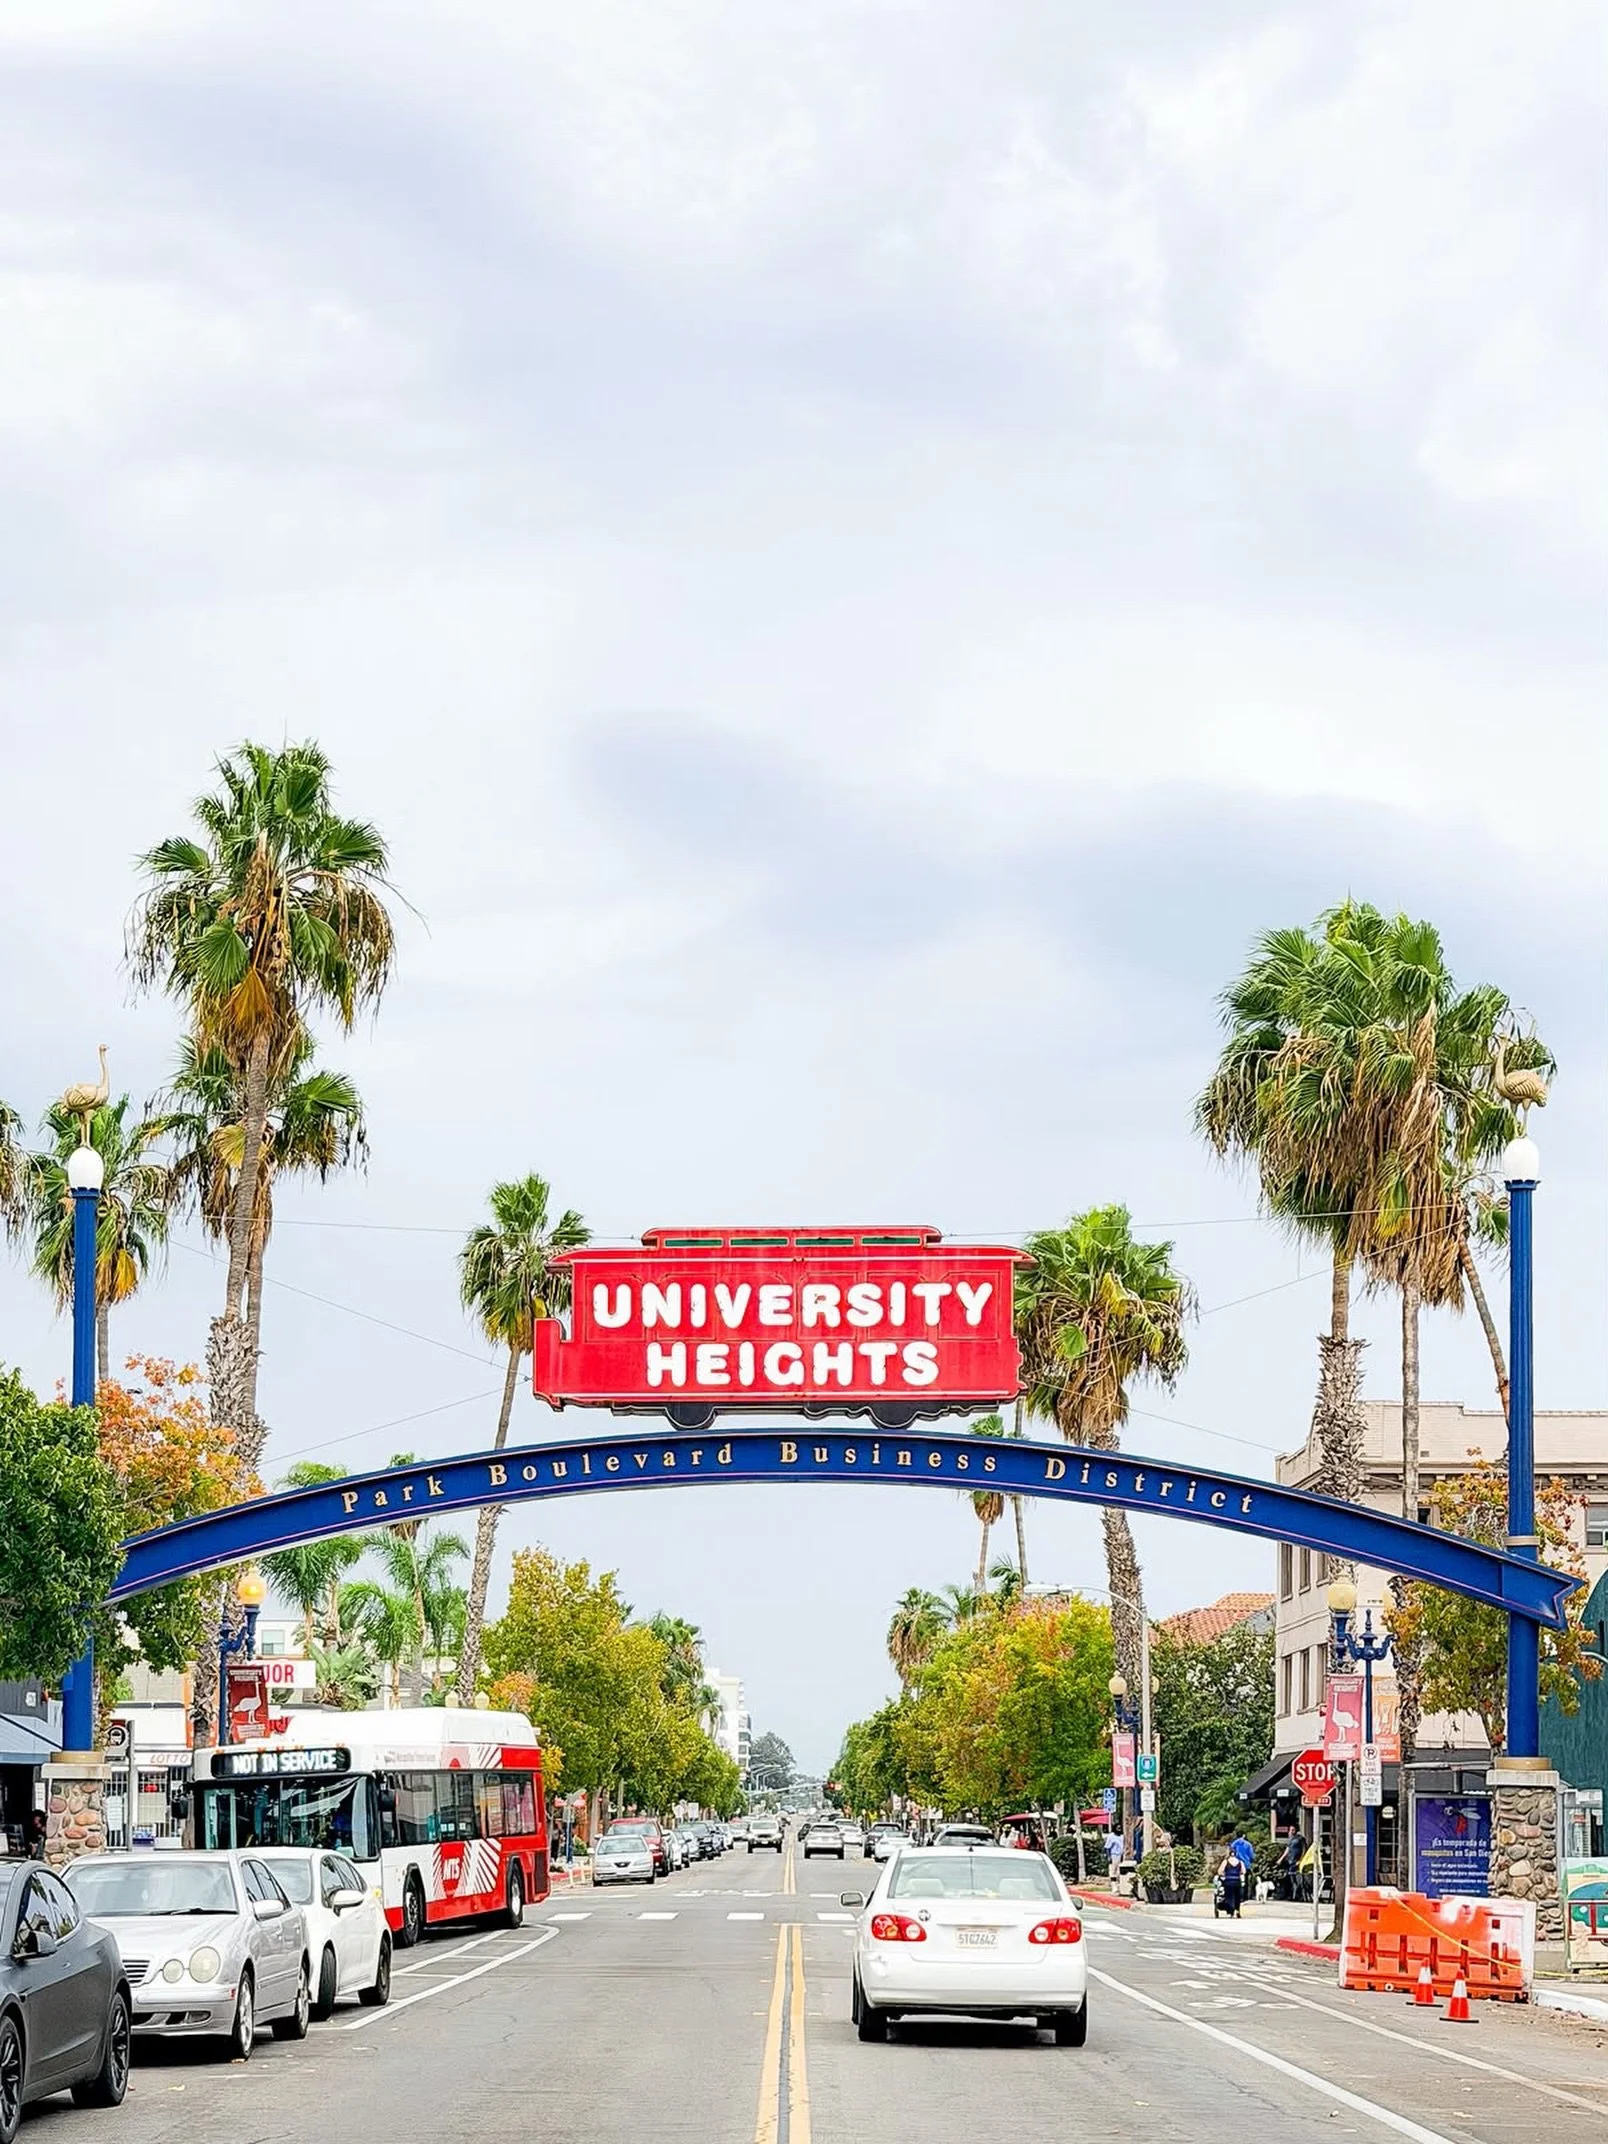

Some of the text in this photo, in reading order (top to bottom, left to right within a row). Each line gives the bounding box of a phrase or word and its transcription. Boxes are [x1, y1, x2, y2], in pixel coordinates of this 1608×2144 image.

[593, 1281, 993, 1329] UNIVERSITY
[646, 1341, 940, 1387] HEIGHTS
[342, 1441, 1253, 1514] Park Boulevard Business District
[150, 1754, 190, 1764] LOTTO
[233, 1750, 337, 1774] NOT IN SERVICE
[1464, 1848, 1477, 1857] San
